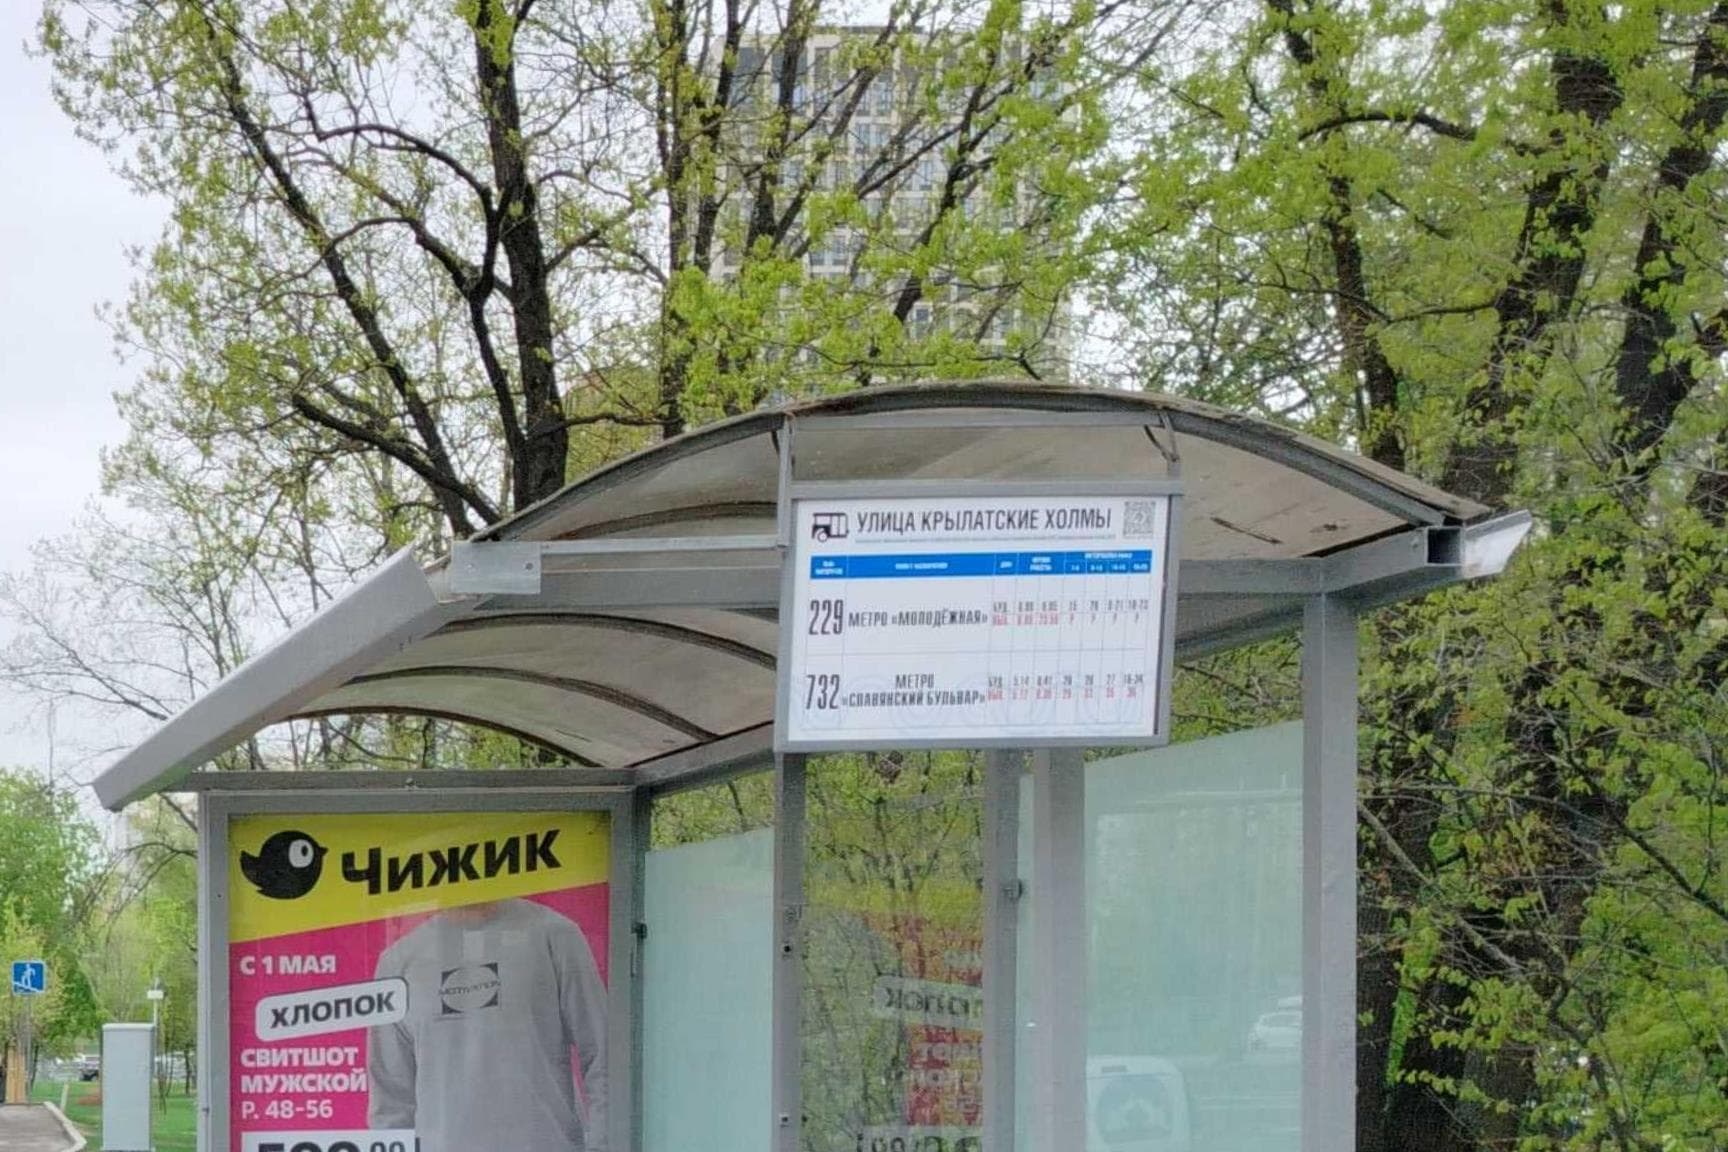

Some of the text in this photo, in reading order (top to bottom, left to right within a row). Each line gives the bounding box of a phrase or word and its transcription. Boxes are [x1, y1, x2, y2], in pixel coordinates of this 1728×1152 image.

[856, 508, 1111, 535] УЛИЦА КРЫЛАТСКИЕ ХОЛМЫ
[808, 599, 844, 635] 229
[848, 611, 888, 627] МЕТРО
[805, 674, 840, 710] 732
[895, 673, 935, 689] МЕТРО
[240, 954, 337, 975] С 1 МАЯ
[270, 990, 396, 1029] ХЛОПОК
[241, 1047, 359, 1067] СВИТШОТ
[241, 1067, 368, 1093] МУЖСКОЙ
[265, 1099, 334, 1119] 48-56
